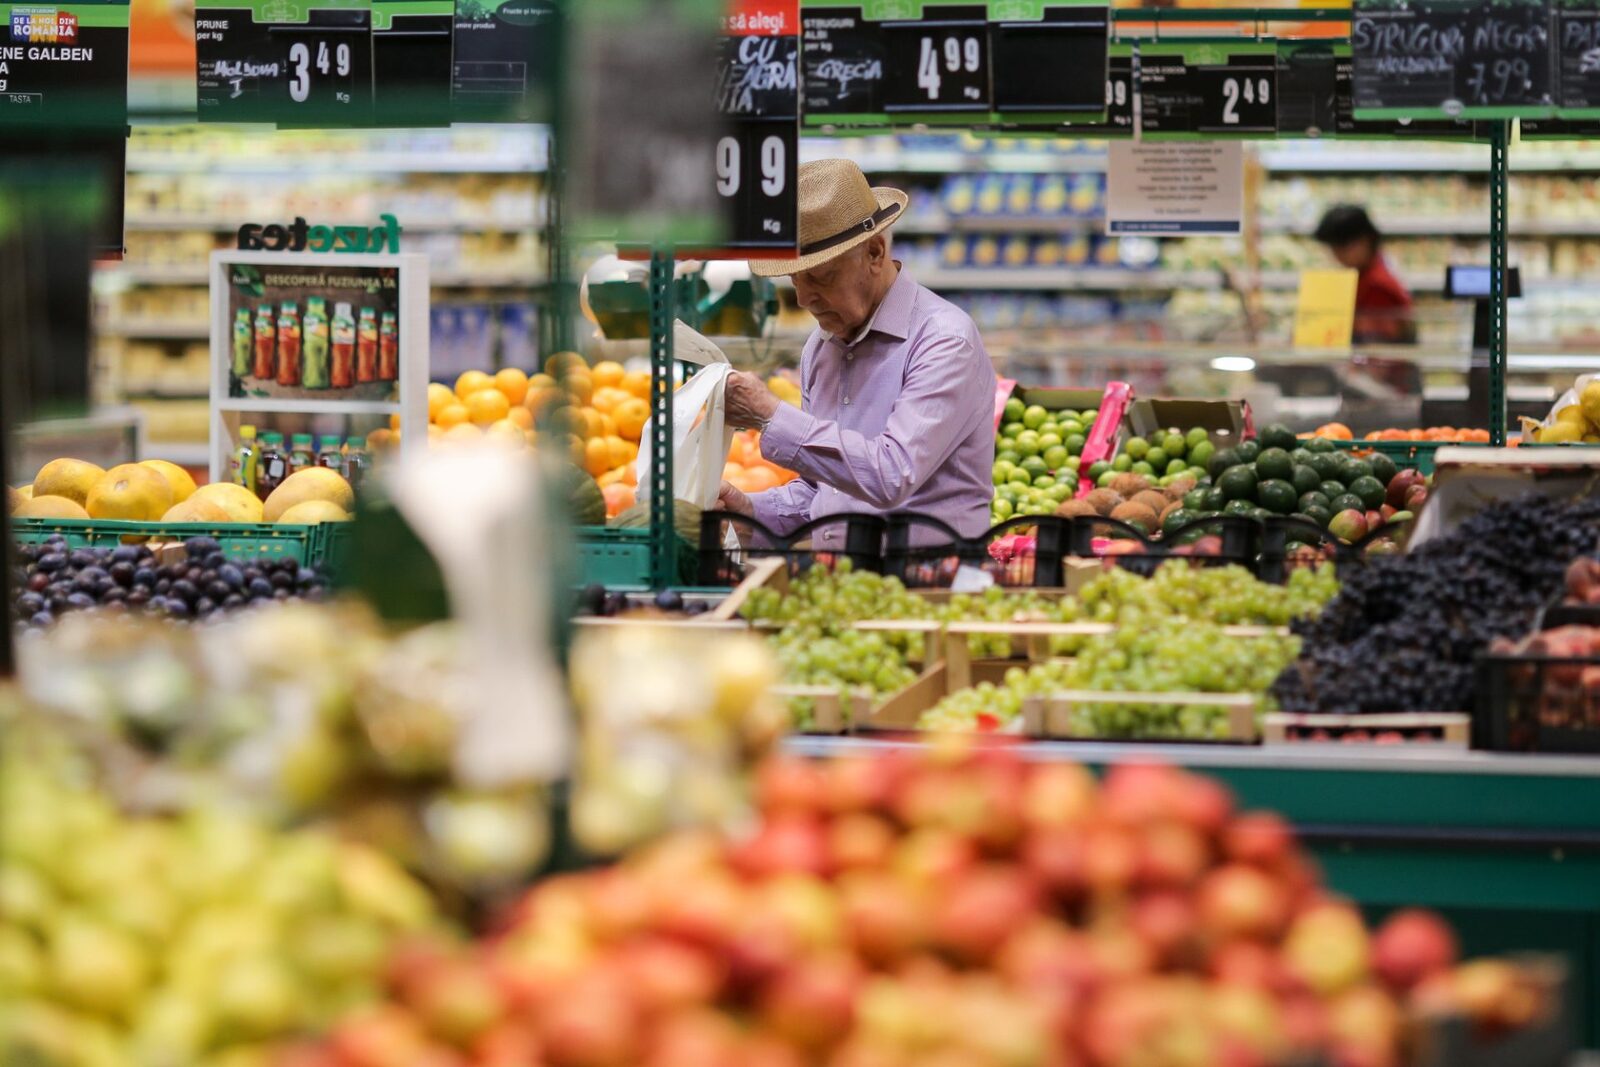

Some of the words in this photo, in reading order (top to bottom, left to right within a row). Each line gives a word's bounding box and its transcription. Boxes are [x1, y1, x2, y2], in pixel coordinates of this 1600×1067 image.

[59, 17, 75, 25] DIN
[196, 20, 229, 30] PRUNE
[212, 31, 223, 41] kg
[28, 47, 93, 61] GALBEN
[9, 94, 31, 103] TASTA
[336, 92, 350, 103] Kg
[763, 219, 781, 234] Kg
